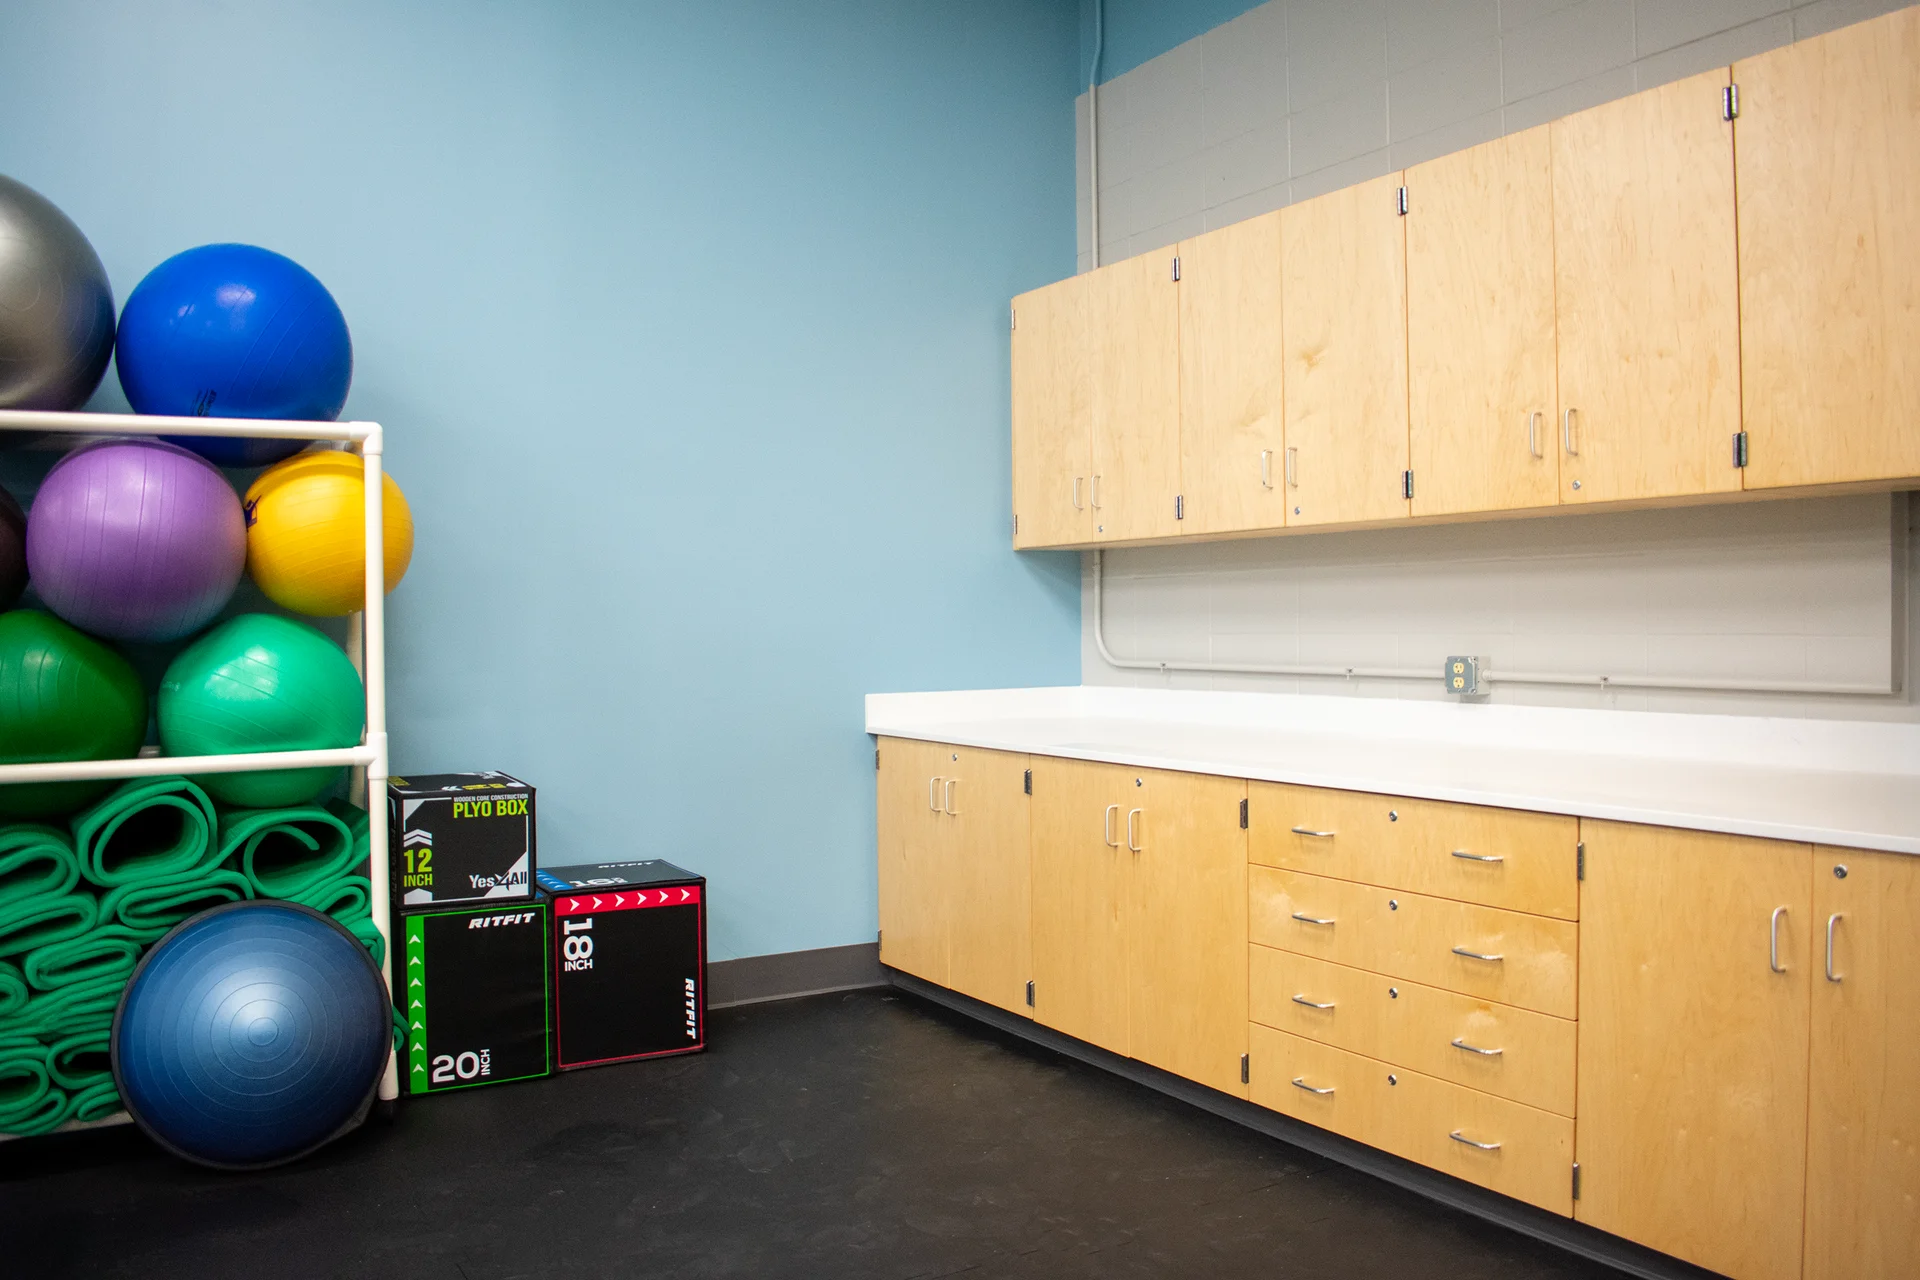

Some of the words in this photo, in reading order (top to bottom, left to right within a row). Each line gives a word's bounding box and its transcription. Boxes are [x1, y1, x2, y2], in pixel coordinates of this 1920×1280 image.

[453, 795, 476, 803] WOODEN
[476, 794, 491, 802] CORE
[491, 793, 529, 801] CONSTRUCTION
[453, 801, 492, 819] PLYO
[496, 799, 529, 816] BOX
[403, 848, 433, 873] 12
[403, 873, 433, 888] INCH
[468, 871, 528, 891] Yes4All
[468, 911, 536, 930] RITFIT
[563, 917, 594, 961] 18
[564, 958, 594, 972] INCH
[684, 977, 697, 1040] RITFIT
[432, 1051, 480, 1083] 20
[480, 1048, 491, 1076] INCH
